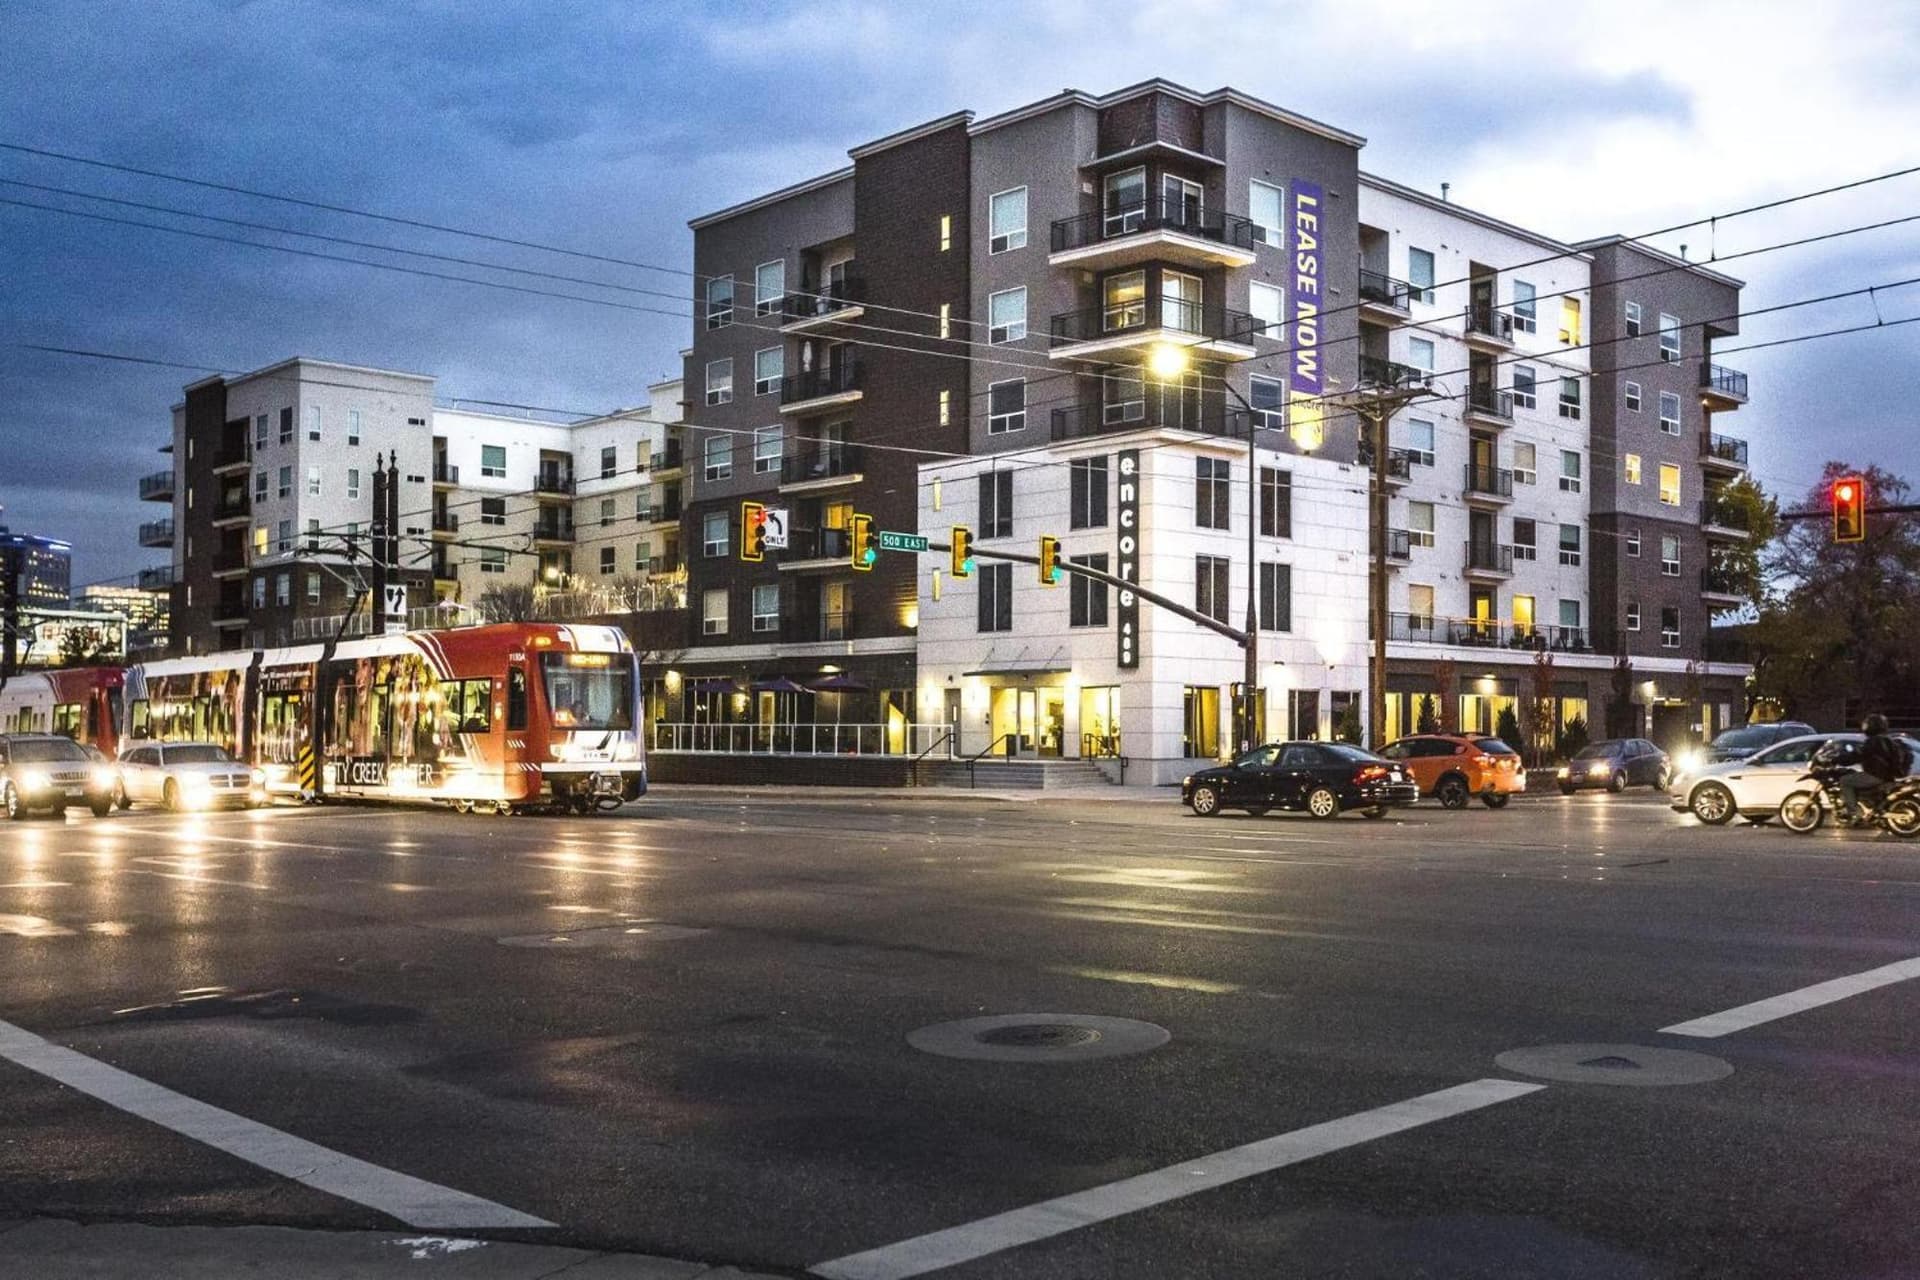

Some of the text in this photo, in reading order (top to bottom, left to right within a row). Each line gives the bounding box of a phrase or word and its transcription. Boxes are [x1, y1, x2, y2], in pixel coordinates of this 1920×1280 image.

[1296, 193, 1318, 383] LEASE NOW
[764, 535, 785, 545] ONLY
[883, 535, 926, 549] 500 EAST
[1119, 456, 1136, 607] encore
[352, 762, 387, 786] CREEK
[390, 762, 434, 785] TER
